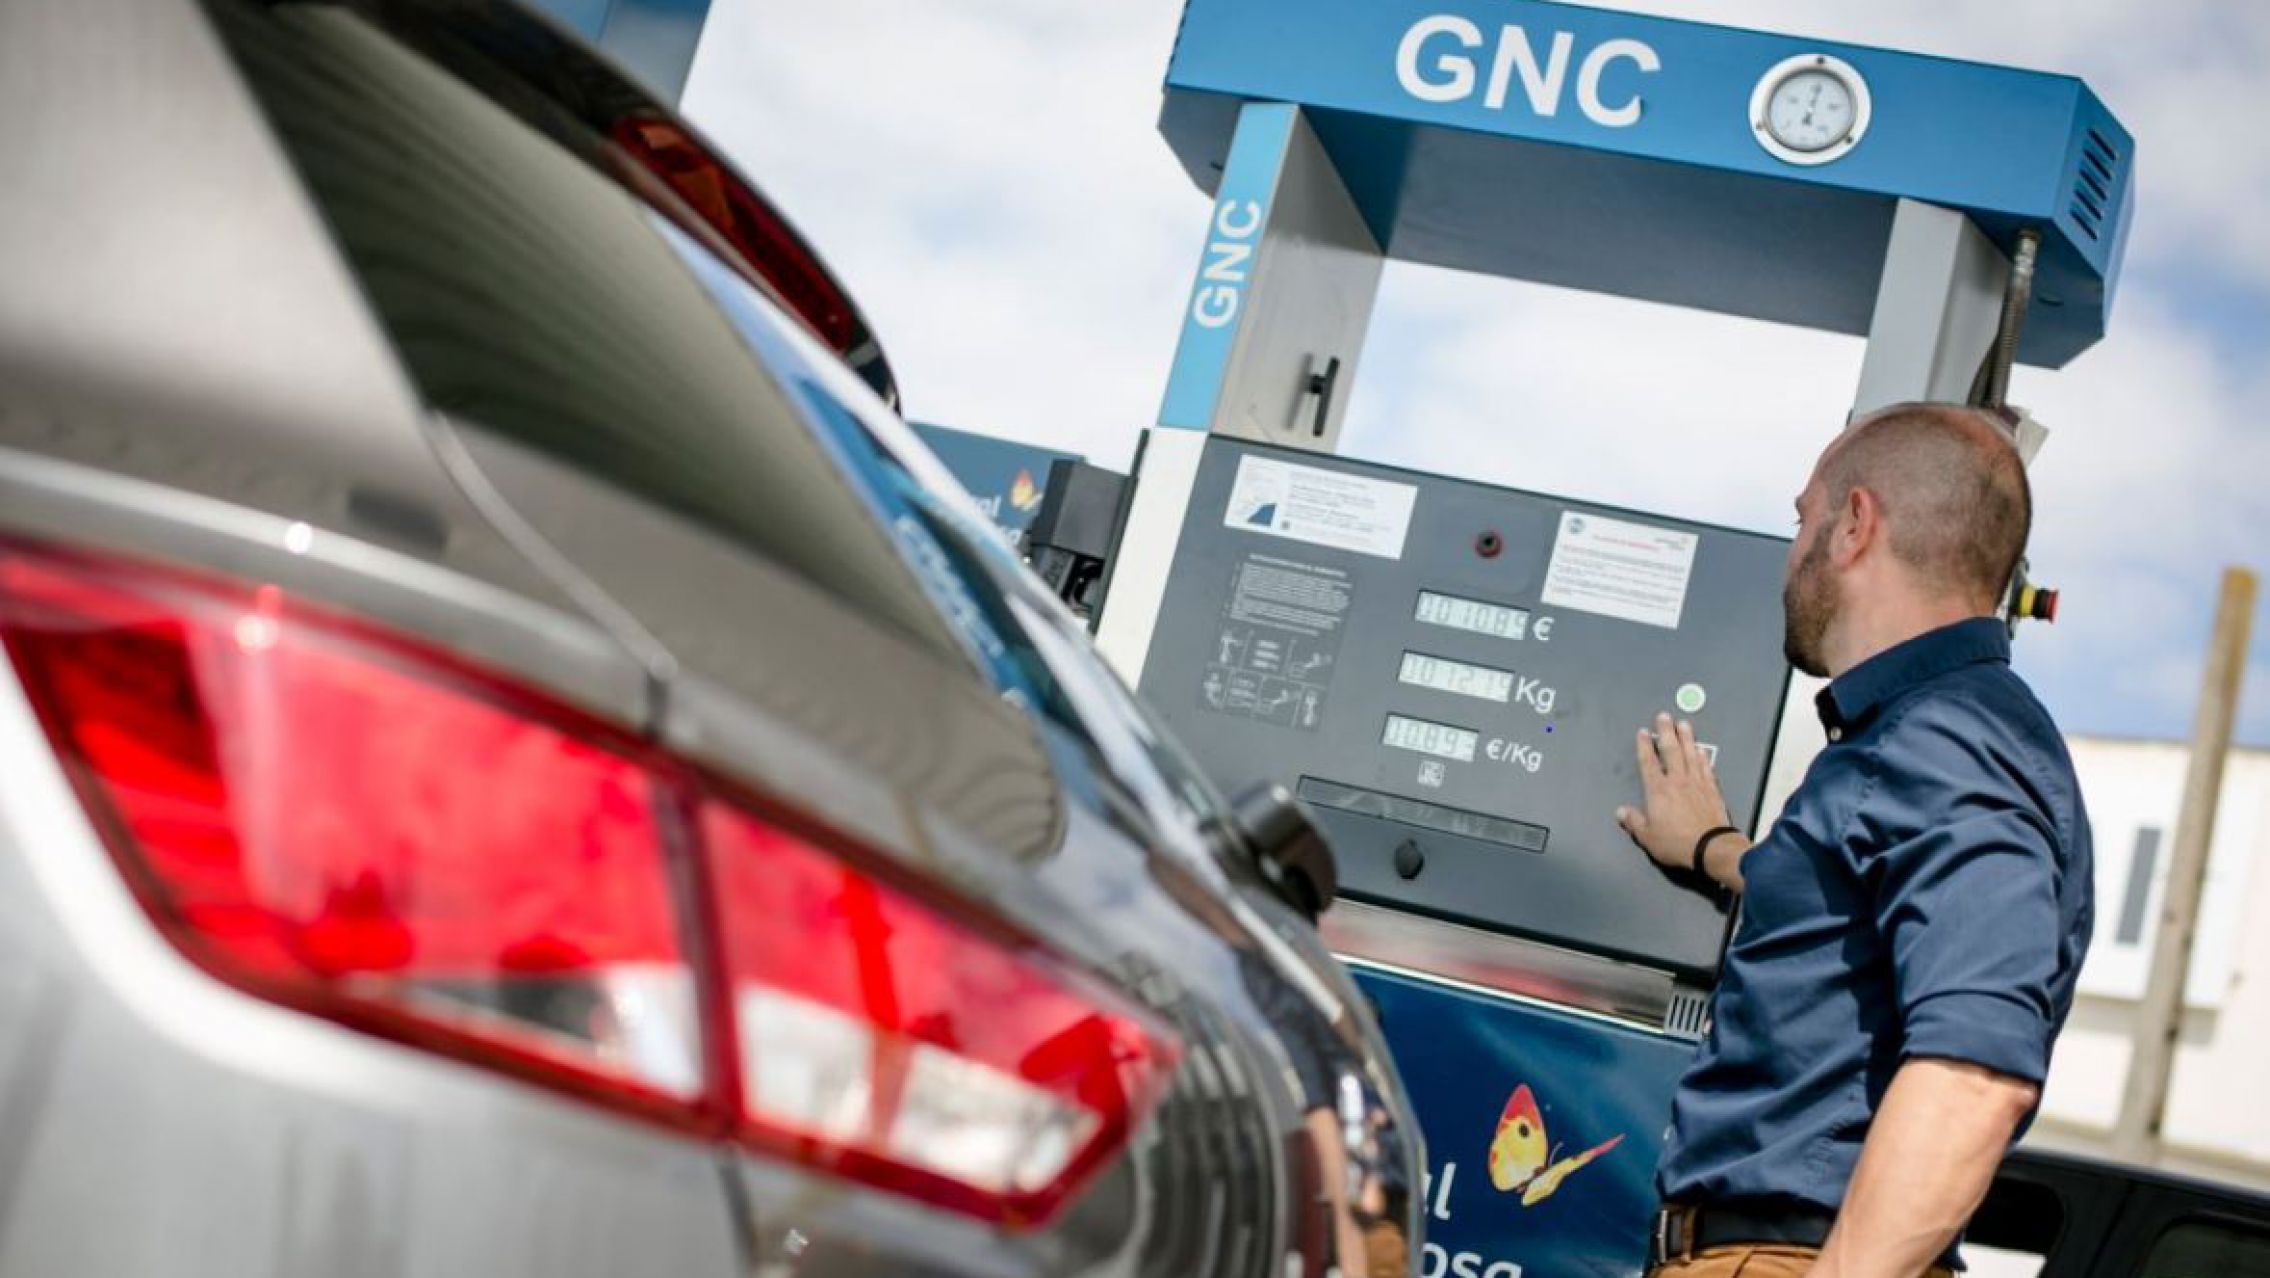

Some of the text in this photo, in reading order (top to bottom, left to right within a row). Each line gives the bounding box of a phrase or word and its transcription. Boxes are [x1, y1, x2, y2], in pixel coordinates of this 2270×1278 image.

[1396, 14, 1661, 127] GNC
[1194, 200, 1261, 328] GNC
[1532, 616, 1555, 641] €
[1515, 677, 1556, 714] Kg
[1486, 738, 1543, 773] €/Kg
